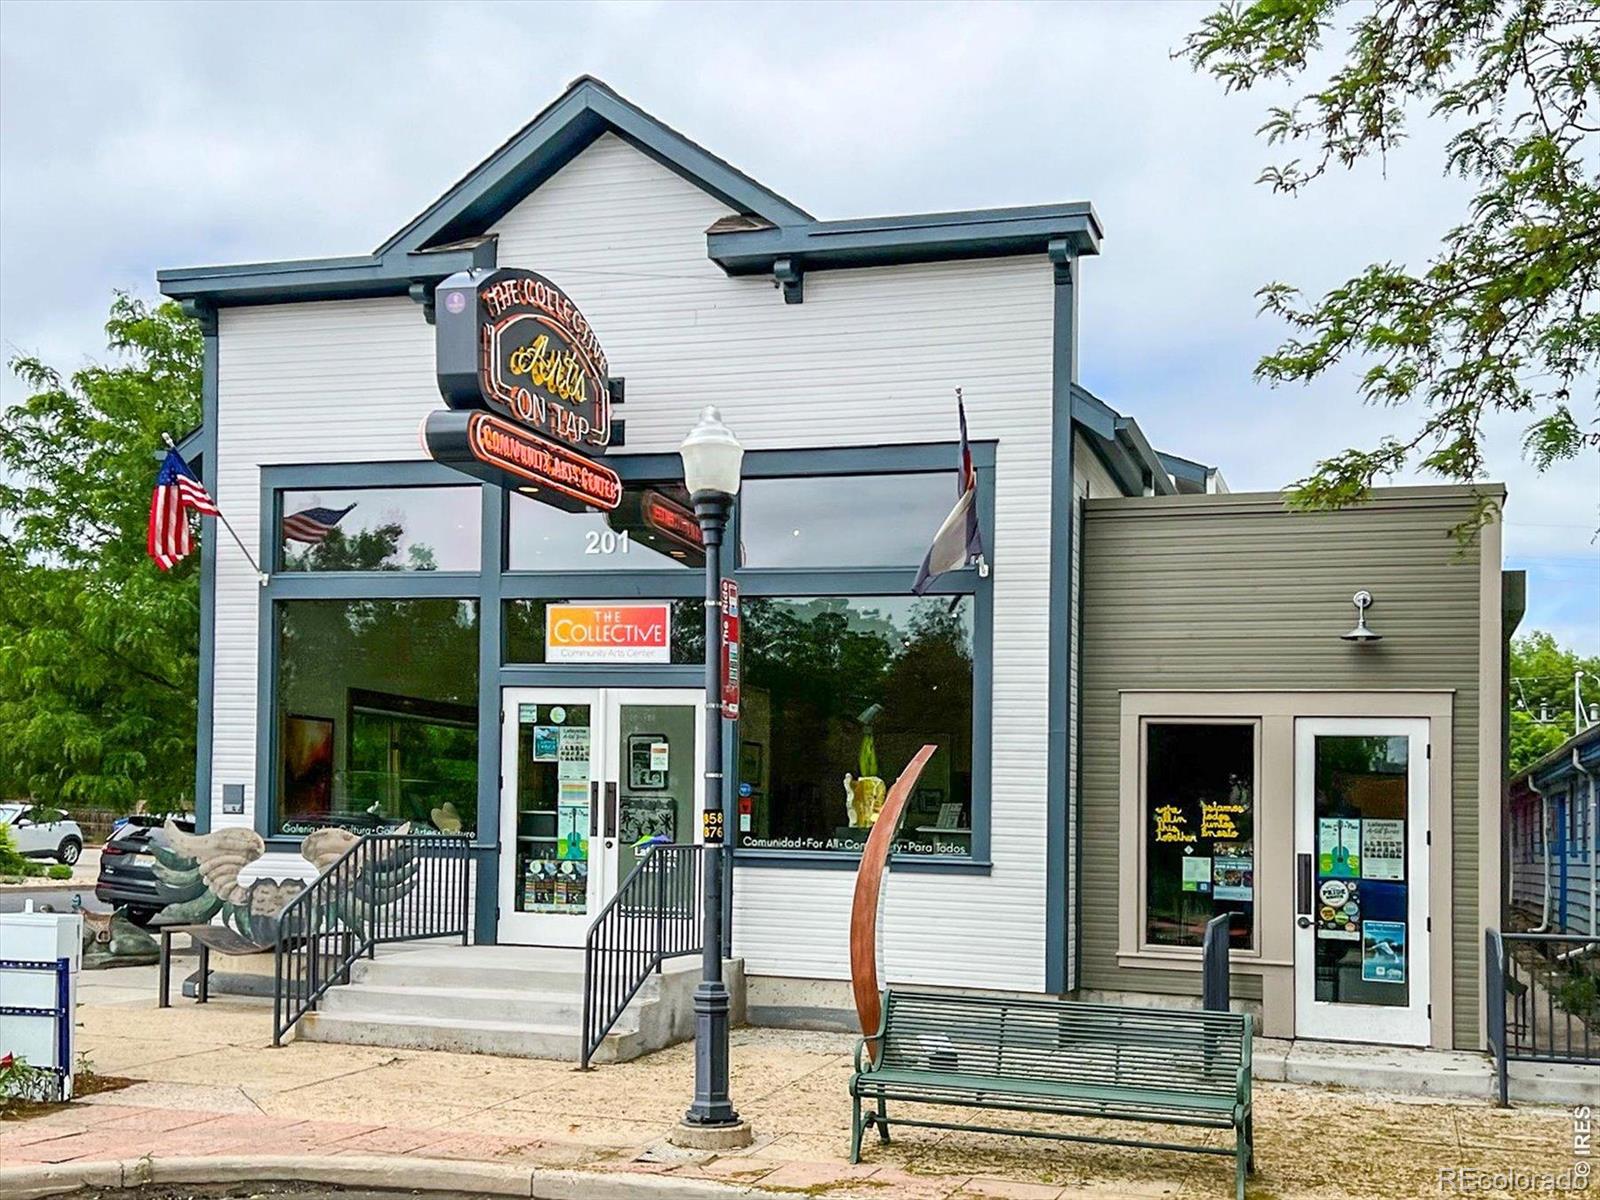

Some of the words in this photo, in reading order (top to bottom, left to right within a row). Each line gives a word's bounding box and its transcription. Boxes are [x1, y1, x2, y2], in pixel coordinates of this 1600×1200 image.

[486, 279, 520, 315] THE
[516, 388, 546, 424] ON
[552, 402, 591, 442] TAP
[585, 530, 630, 554] 201
[594, 611, 621, 622] THE
[560, 649, 606, 658] Community
[607, 649, 625, 657] Arts
[627, 649, 655, 657] Center
[743, 836, 801, 848] Comunidad
[806, 838, 824, 849] For
[826, 838, 839, 849] All
[908, 843, 932, 853] Para
[936, 843, 966, 854] Todos
